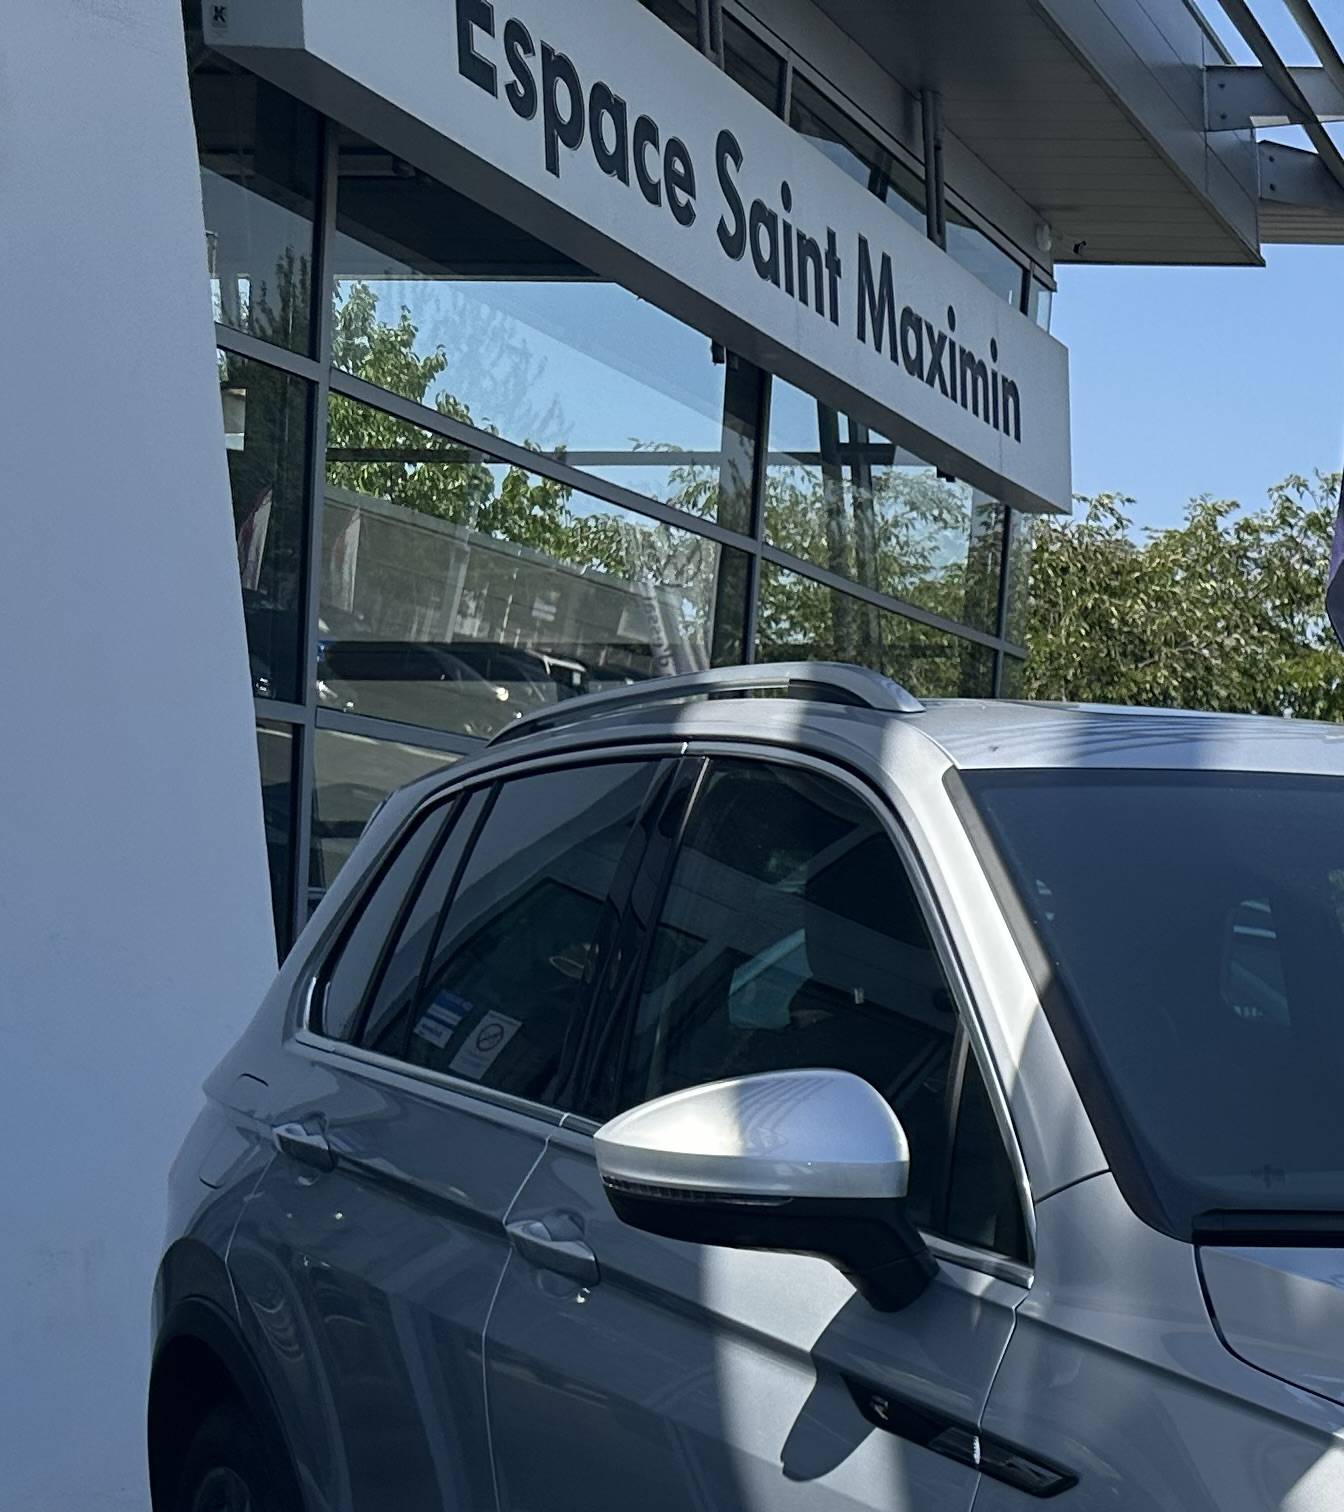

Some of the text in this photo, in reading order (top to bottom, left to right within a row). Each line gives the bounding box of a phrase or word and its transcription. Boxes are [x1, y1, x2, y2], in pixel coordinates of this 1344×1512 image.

[456, 0, 1022, 443] Espace Saint Maximin
